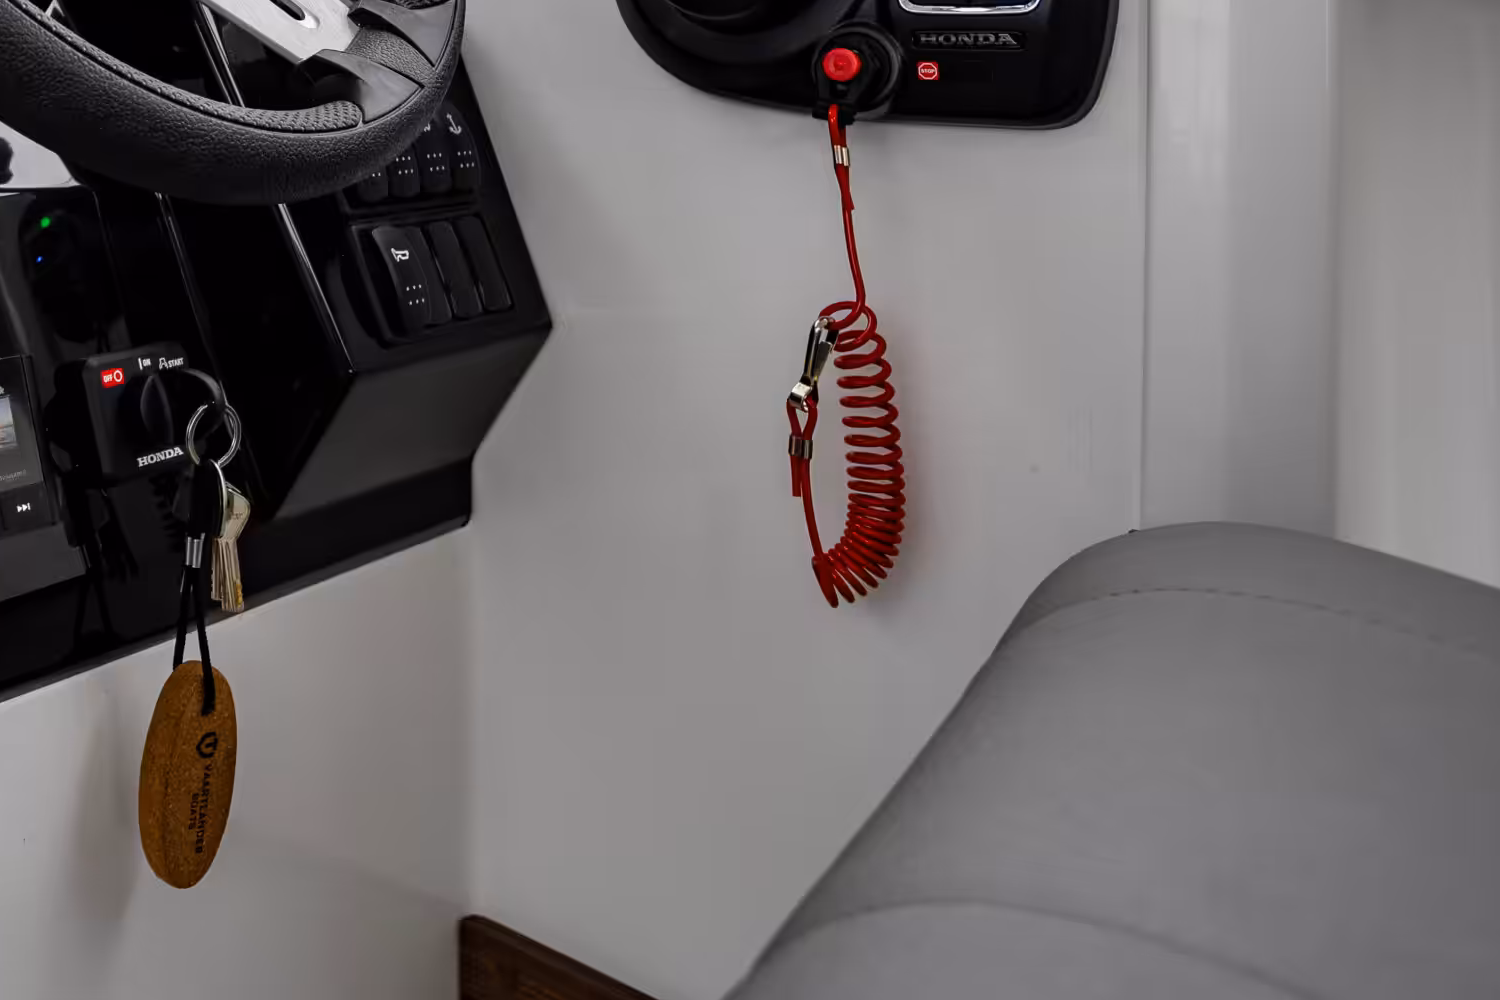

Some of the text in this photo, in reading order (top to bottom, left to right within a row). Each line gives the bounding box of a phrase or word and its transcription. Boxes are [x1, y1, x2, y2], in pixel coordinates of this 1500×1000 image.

[920, 33, 1017, 45] HONDA
[142, 359, 151, 367] ON
[168, 357, 184, 368] START
[103, 374, 113, 383] OFF
[137, 446, 184, 467] HONDA
